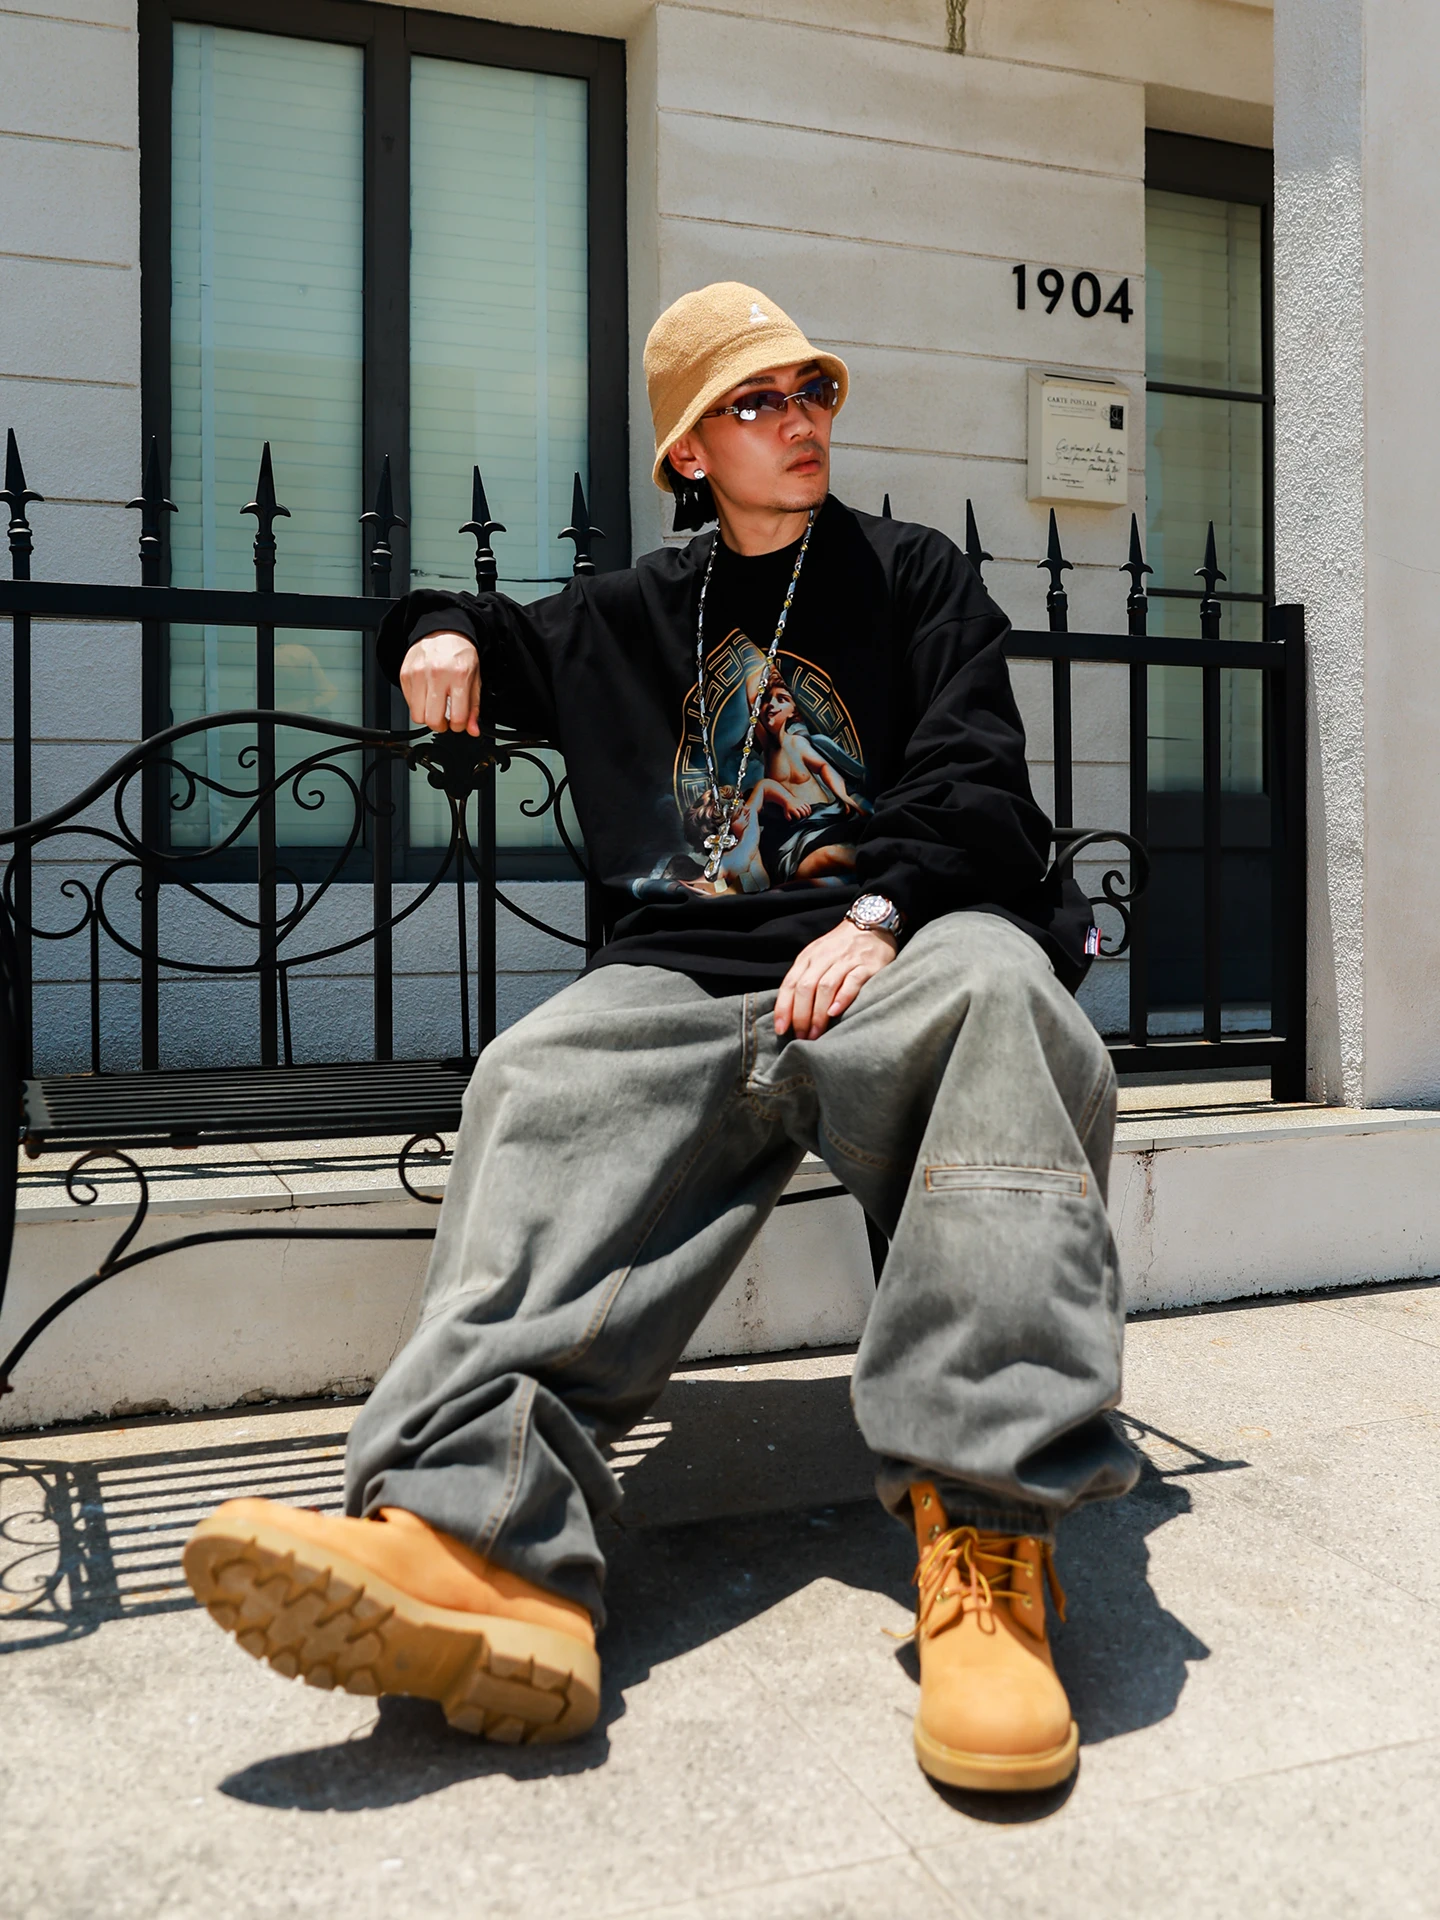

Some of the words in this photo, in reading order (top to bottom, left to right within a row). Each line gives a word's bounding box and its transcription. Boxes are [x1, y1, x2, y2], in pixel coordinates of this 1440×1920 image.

[1012, 264, 1134, 323] 1904
[1047, 396, 1067, 404] CARTE
[1070, 398, 1097, 407] POSTALE
